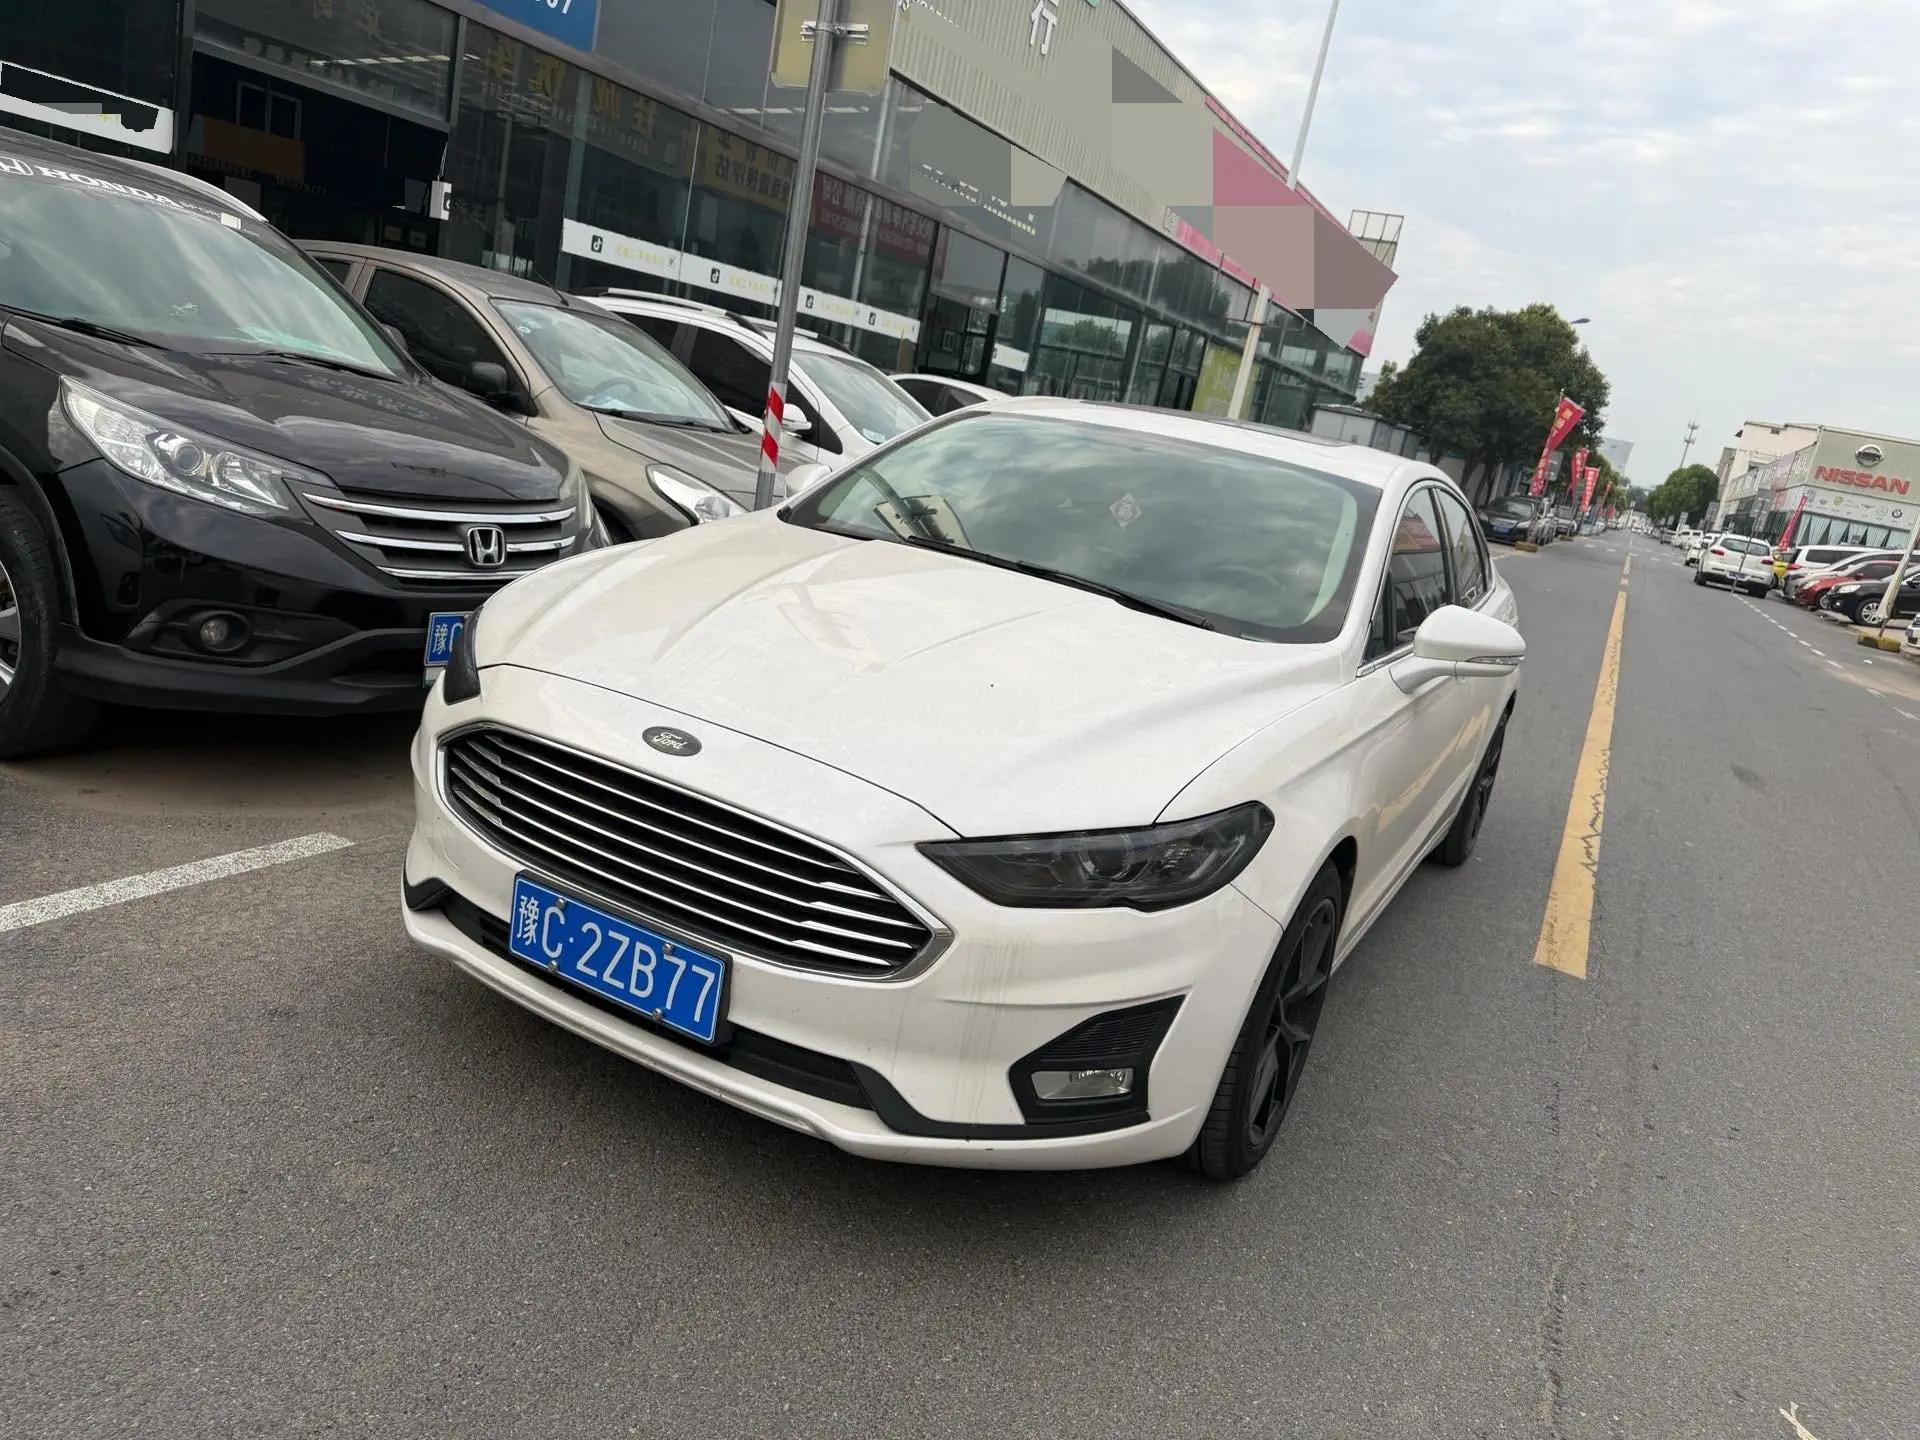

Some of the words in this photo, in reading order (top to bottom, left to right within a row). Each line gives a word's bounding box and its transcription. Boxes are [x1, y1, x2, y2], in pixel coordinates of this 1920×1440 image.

[33, 164, 185, 209] HONDA
[1814, 465, 1910, 495] NISSAN
[653, 731, 684, 750] Ford
[516, 894, 716, 1023] 豫C·2ZB77
